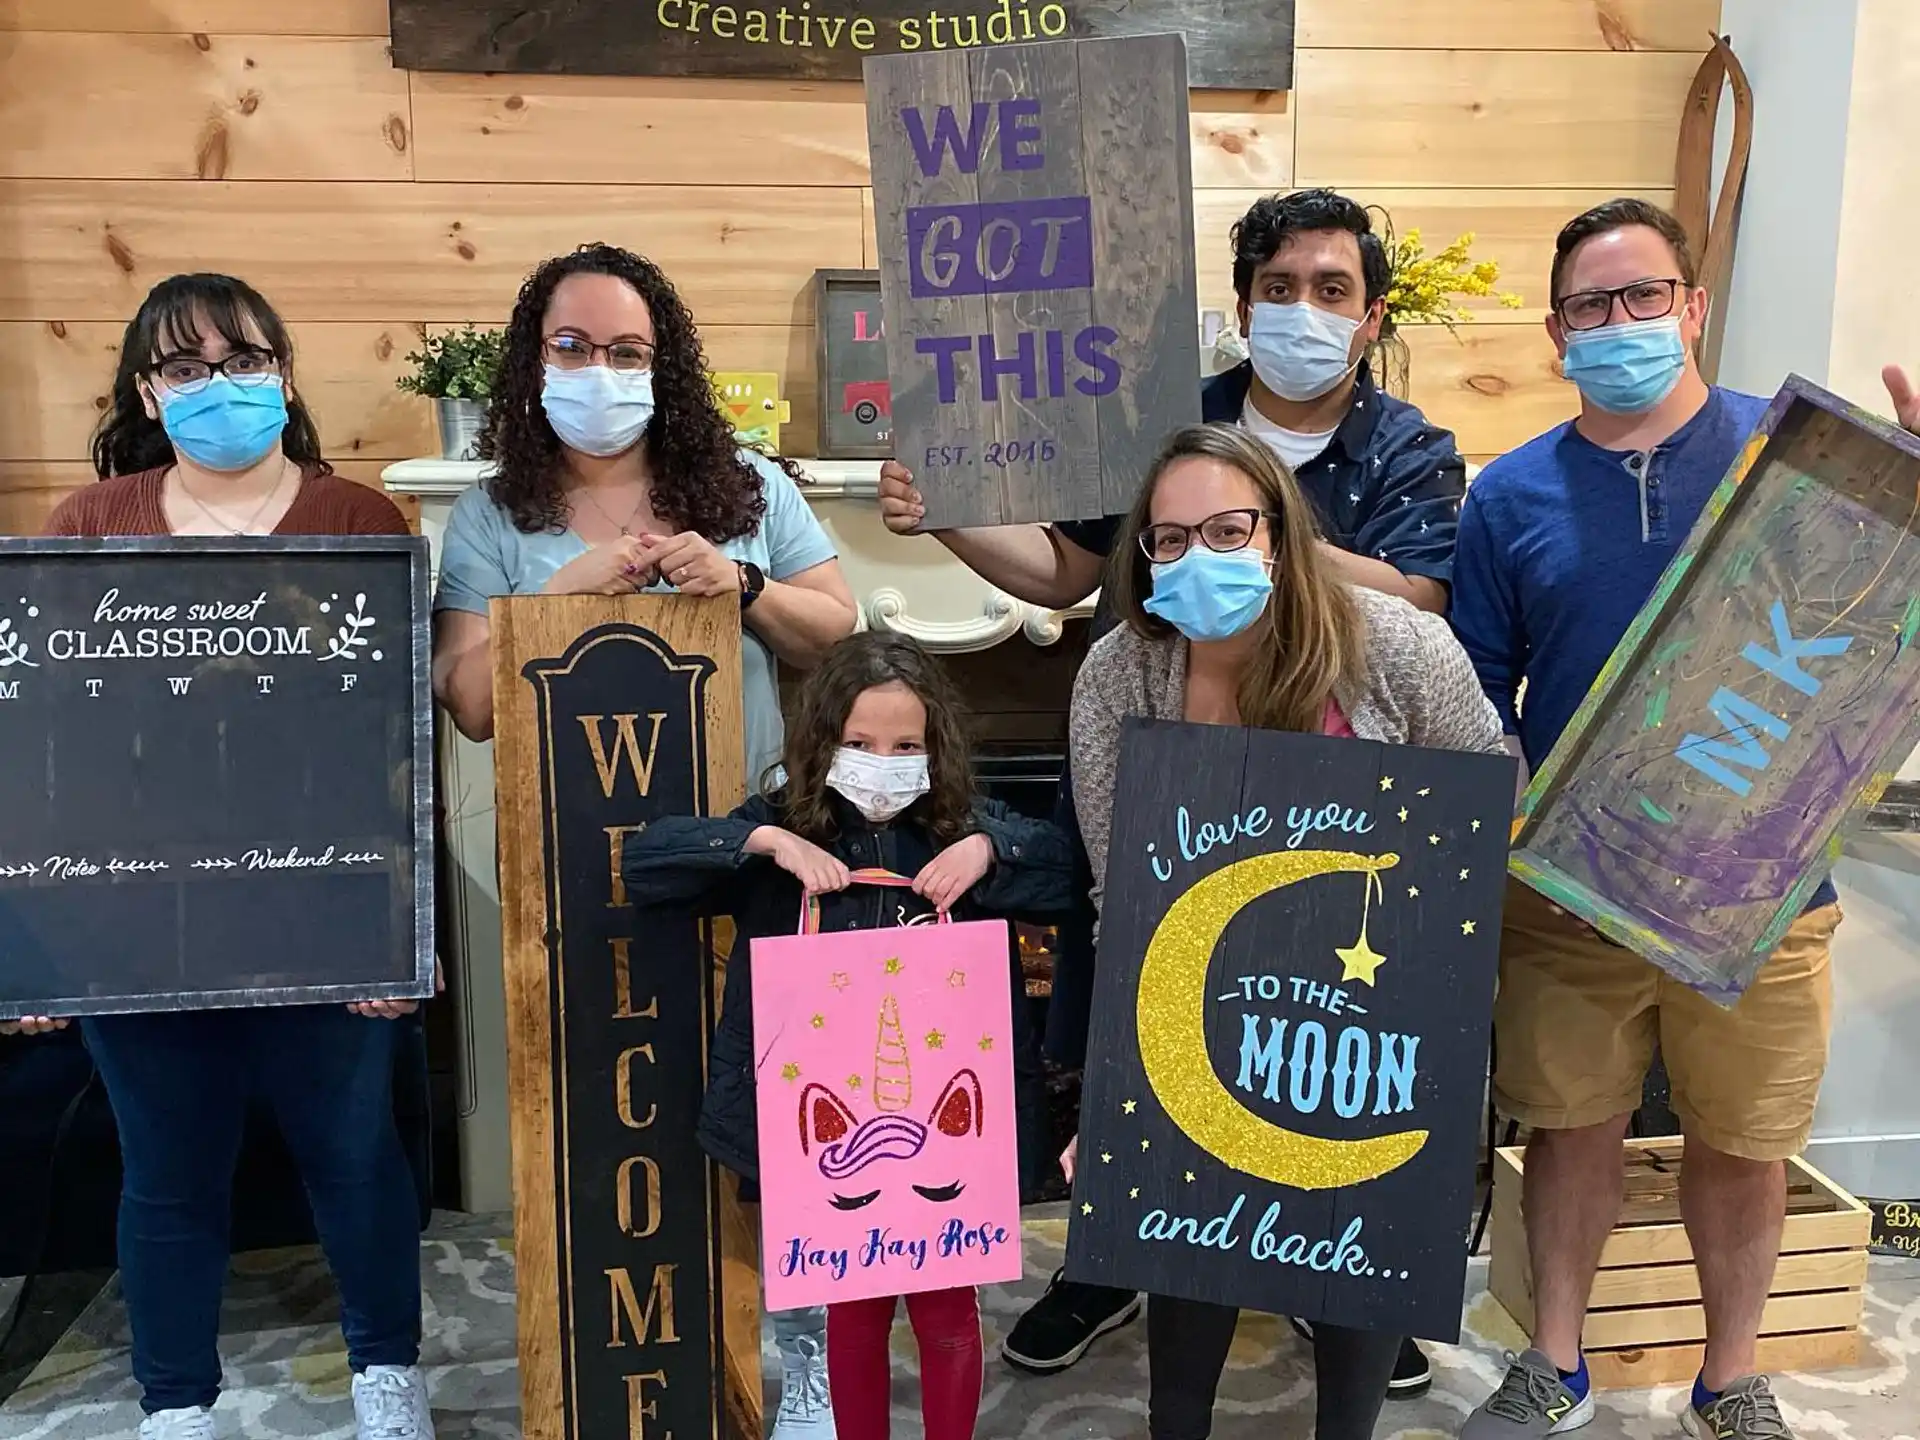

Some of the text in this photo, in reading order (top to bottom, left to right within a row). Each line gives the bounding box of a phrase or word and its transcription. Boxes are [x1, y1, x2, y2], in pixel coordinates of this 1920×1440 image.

[656, 0, 1068, 50] creative studio
[901, 98, 1045, 177] WE
[920, 214, 1083, 288] GOT
[915, 325, 1123, 404] THIS
[925, 445, 973, 468] EST.
[93, 587, 269, 623] home sweet
[46, 626, 313, 660] CLASSROOM
[0, 673, 358, 699] M T W T F
[43, 845, 335, 879] Notes Weekend
[1146, 802, 1377, 881] i love you
[1237, 974, 1349, 1016] TO THE
[1235, 1013, 1421, 1119] MOON
[1138, 1193, 1246, 1250] and
[778, 1218, 1010, 1281] Kay Kay Rose
